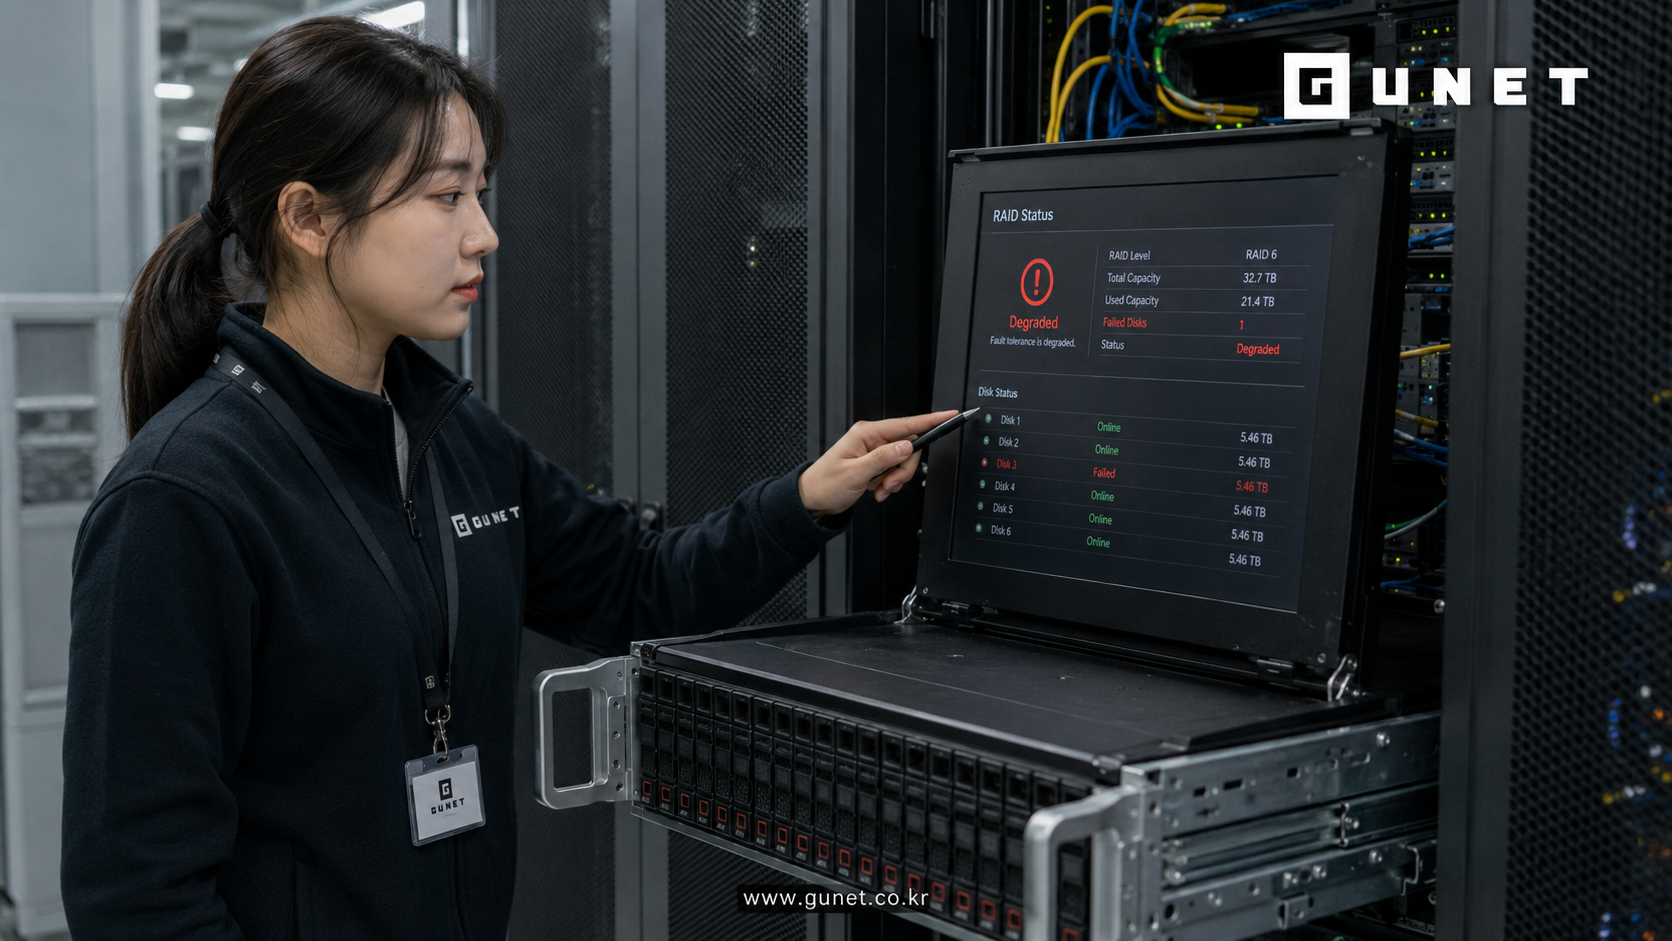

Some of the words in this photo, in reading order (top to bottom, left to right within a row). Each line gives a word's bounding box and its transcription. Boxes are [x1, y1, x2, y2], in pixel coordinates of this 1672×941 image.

[993, 208, 1018, 223] RAID
[1021, 208, 1053, 222] Status
[1109, 250, 1128, 261] RAID
[1129, 249, 1150, 261] Level
[1245, 248, 1268, 260] RAID
[1270, 248, 1278, 260] 6
[1107, 272, 1125, 283] Total
[1126, 272, 1160, 286] Capacity
[1242, 272, 1262, 284] 32.7
[1264, 272, 1277, 284] TB
[1105, 294, 1124, 305] Used
[1125, 294, 1159, 308] Capacity
[1240, 295, 1260, 307] 21.4
[1262, 295, 1275, 307] TB
[1009, 314, 1059, 332] Degraded
[1103, 316, 1126, 328] Failed
[1126, 317, 1148, 328] Disks
[1239, 319, 1244, 331] 1
[989, 335, 1006, 345] Fault
[1006, 336, 1035, 347] tolerance
[1036, 336, 1042, 347] is
[1042, 337, 1075, 349] degraded.
[1101, 338, 1124, 350] Status
[1236, 342, 1281, 357] Degraded
[977, 386, 993, 397] Disk
[994, 387, 1017, 399] Status
[1000, 414, 1015, 426] Disk
[1016, 415, 1021, 426] 1
[1097, 421, 1121, 433] Online
[998, 436, 1013, 447] Disk
[1013, 437, 1020, 448] 2
[1240, 431, 1259, 444] 5.46
[1260, 432, 1273, 445] TB
[1094, 443, 1119, 456] Online
[996, 458, 1010, 470] Disk
[1011, 459, 1018, 470] 3
[1238, 455, 1256, 468] 5.46
[1258, 456, 1271, 469] TB
[1093, 466, 1116, 479] Failed
[994, 480, 1009, 492] Disk
[1010, 482, 1016, 492] 4
[1235, 479, 1254, 492] 5.46
[1256, 481, 1269, 494] TB
[1090, 489, 1114, 502] Online
[992, 502, 1007, 514] Disk
[1233, 504, 1252, 517] 5.46
[1254, 505, 1266, 518] TB
[471, 506, 519, 529] GUNET
[1088, 512, 1112, 526] Online
[990, 524, 1005, 536] Disk
[1006, 526, 1012, 537] 6
[1231, 528, 1249, 541] 5.46
[1251, 530, 1264, 543] TB
[1086, 535, 1110, 549] Online
[1228, 552, 1247, 566] 5.46
[1249, 554, 1262, 567] TB
[431, 798, 465, 815] GUNET
